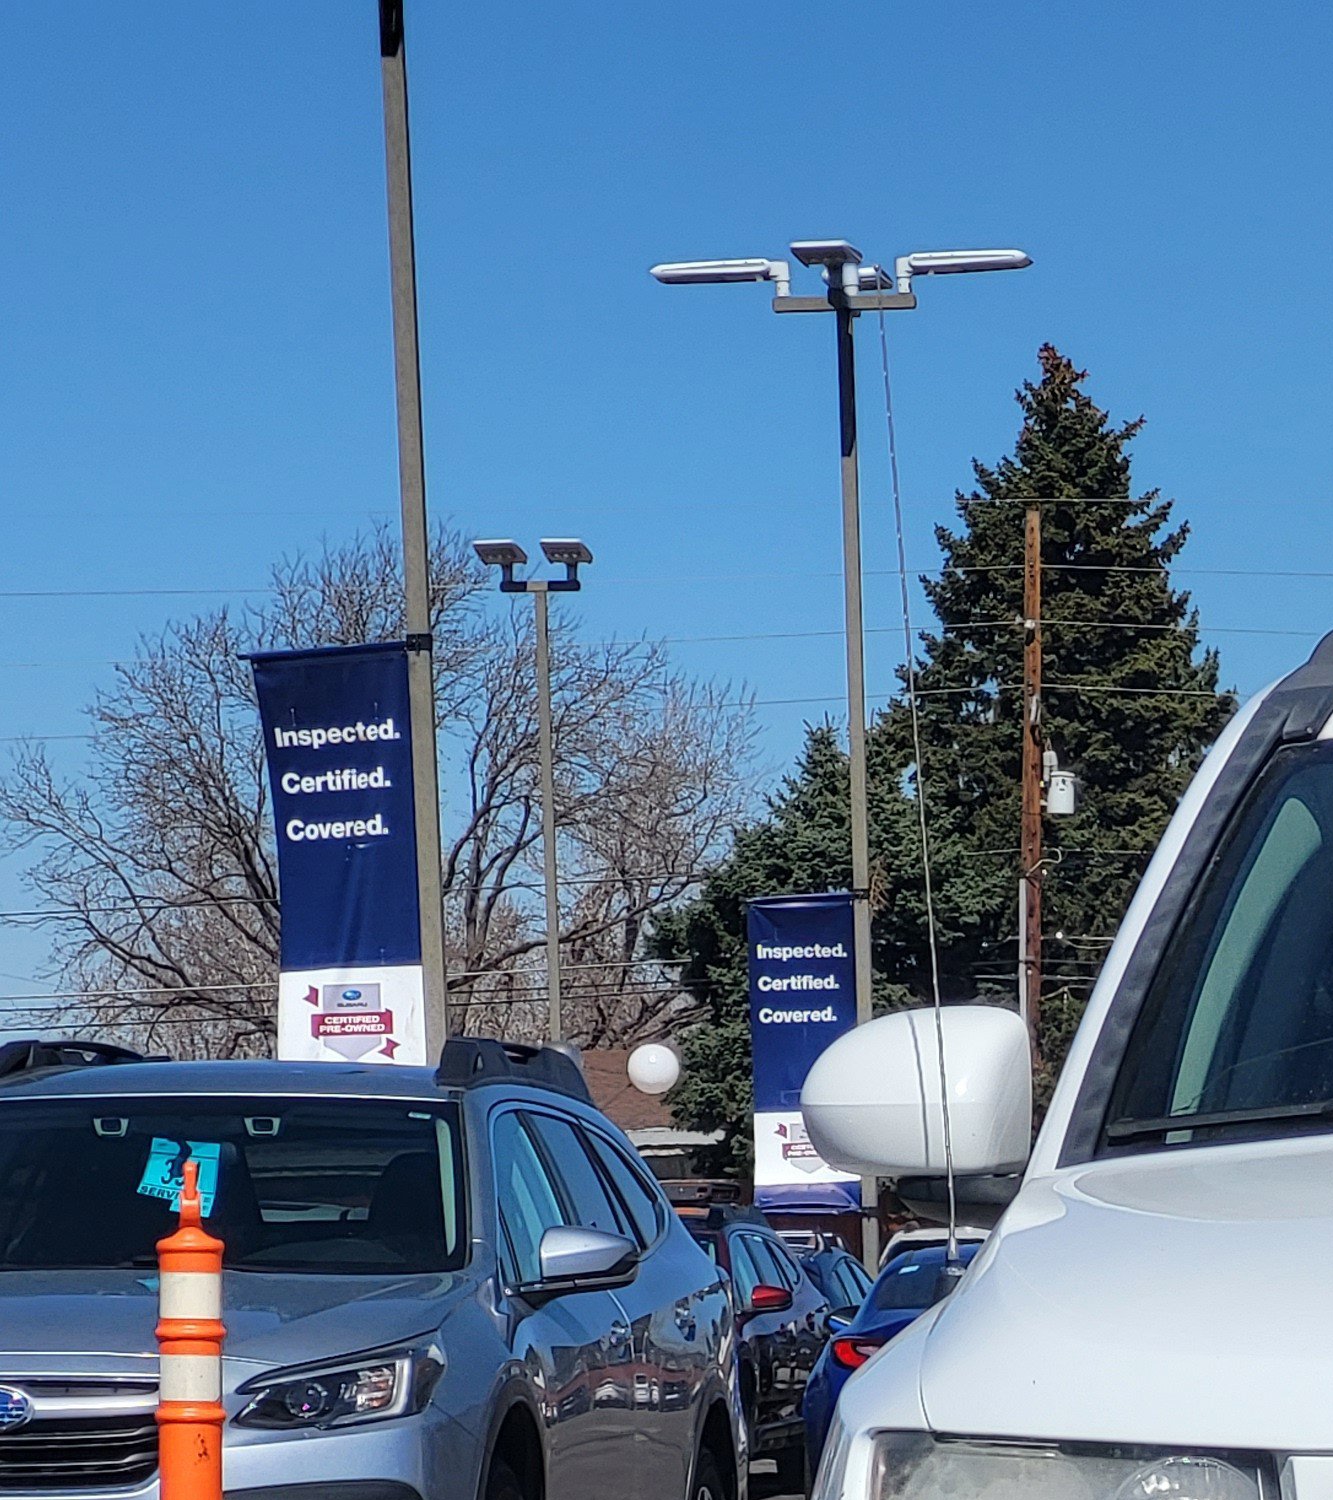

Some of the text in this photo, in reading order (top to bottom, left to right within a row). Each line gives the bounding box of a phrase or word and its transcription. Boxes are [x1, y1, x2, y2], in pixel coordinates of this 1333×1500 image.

[274, 718, 401, 749] Inspected.
[281, 766, 392, 794] Certified.
[286, 813, 389, 841] Covered.
[756, 943, 848, 962] Inspected.
[757, 974, 840, 992] Certified.
[324, 1015, 380, 1025] CERTIFIED
[758, 1006, 838, 1024] Covered.
[319, 1023, 385, 1034] PRE-OWNED
